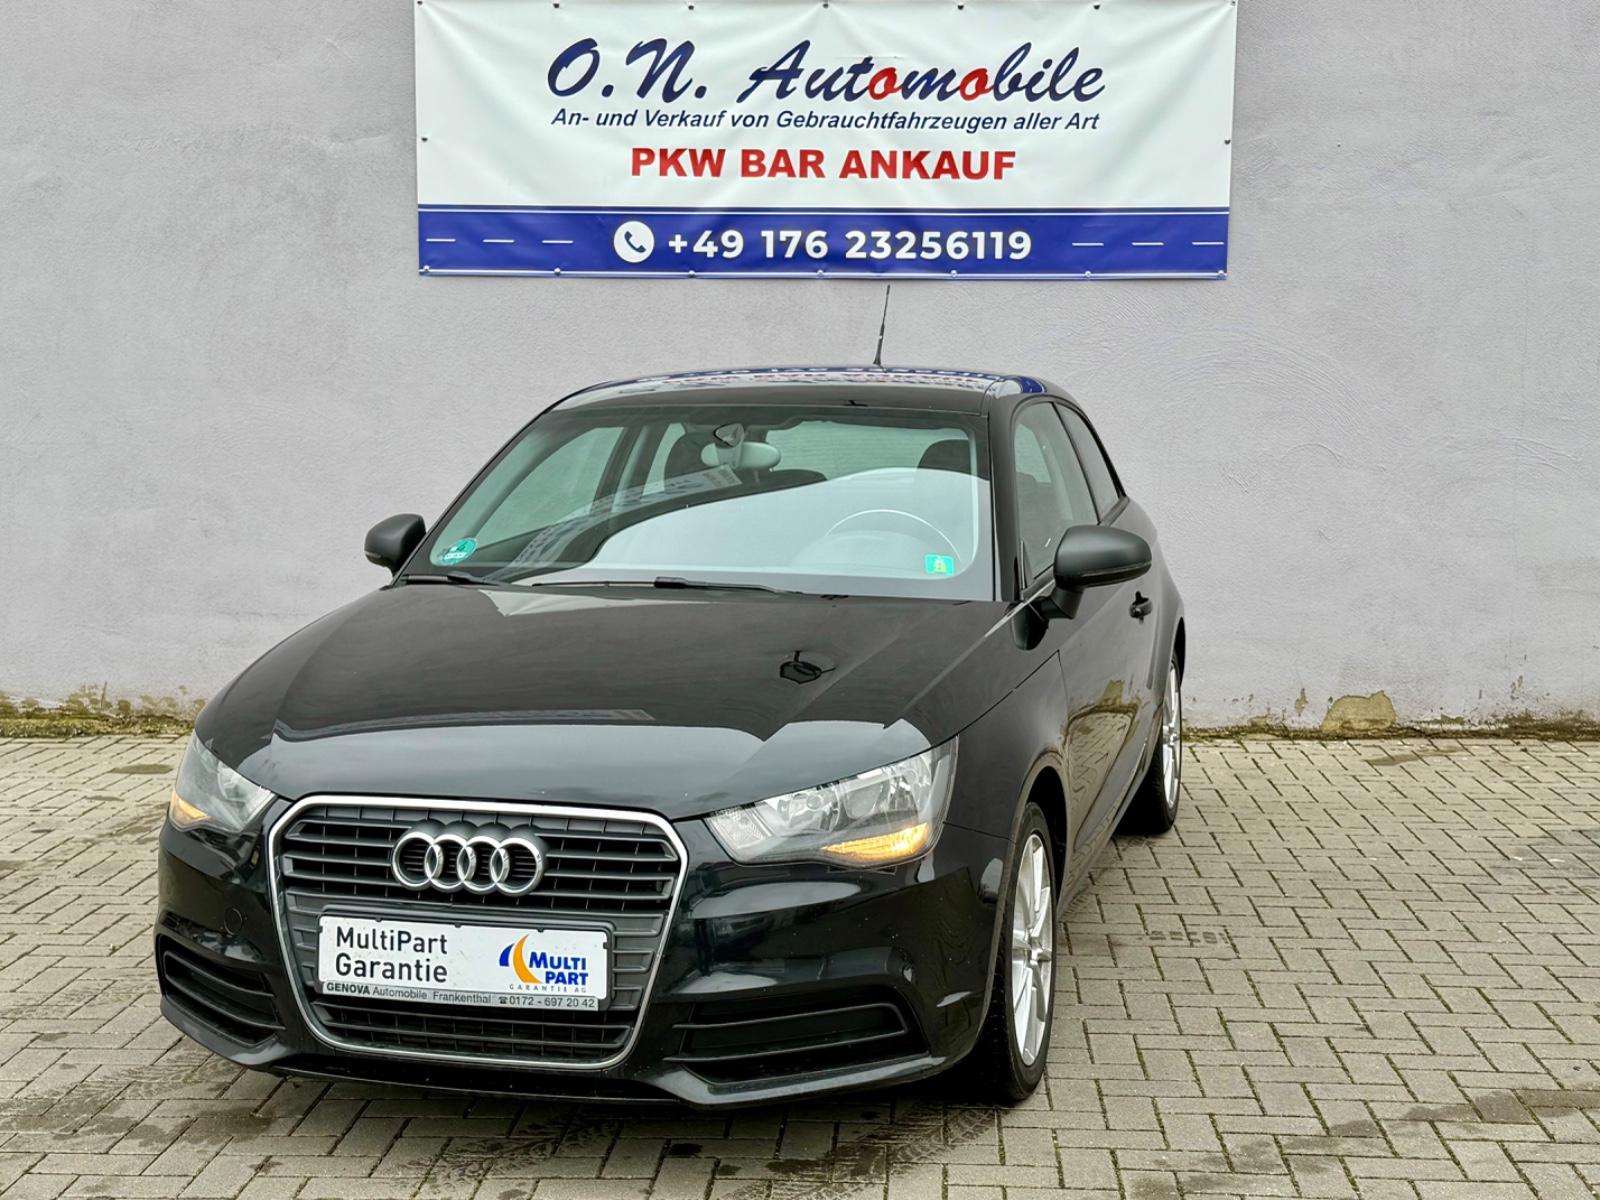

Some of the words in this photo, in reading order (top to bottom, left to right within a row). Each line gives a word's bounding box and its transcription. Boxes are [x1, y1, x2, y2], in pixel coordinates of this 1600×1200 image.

[547, 37, 707, 103] O.N.
[736, 39, 1105, 103] Automobile
[551, 108, 589, 127] An-
[595, 109, 637, 127] und
[645, 109, 727, 128] Verkauf
[731, 114, 769, 128] von
[776, 110, 1007, 134] Gebrauchtfahrzeugen
[1013, 112, 1062, 130] aller
[1064, 112, 1099, 130] Art
[631, 147, 726, 178] PKW
[740, 148, 826, 179] BAR
[839, 149, 1016, 180] ANKAUF
[668, 230, 744, 259] +49
[761, 230, 828, 259] 176
[845, 230, 1032, 260] 23256119
[336, 926, 448, 955] MultiPart
[335, 953, 448, 983] Garantie
[529, 951, 587, 971] MULTI
[509, 983, 569, 993] GARANTIE
[572, 985, 587, 994] AG
[545, 971, 589, 986] PART
[326, 982, 370, 995] GENOVA
[372, 985, 428, 1000] Automobile
[433, 990, 492, 1005] Frankenthal
[544, 996, 564, 1008] 697
[565, 997, 580, 1008] 20
[581, 998, 595, 1009] 42
